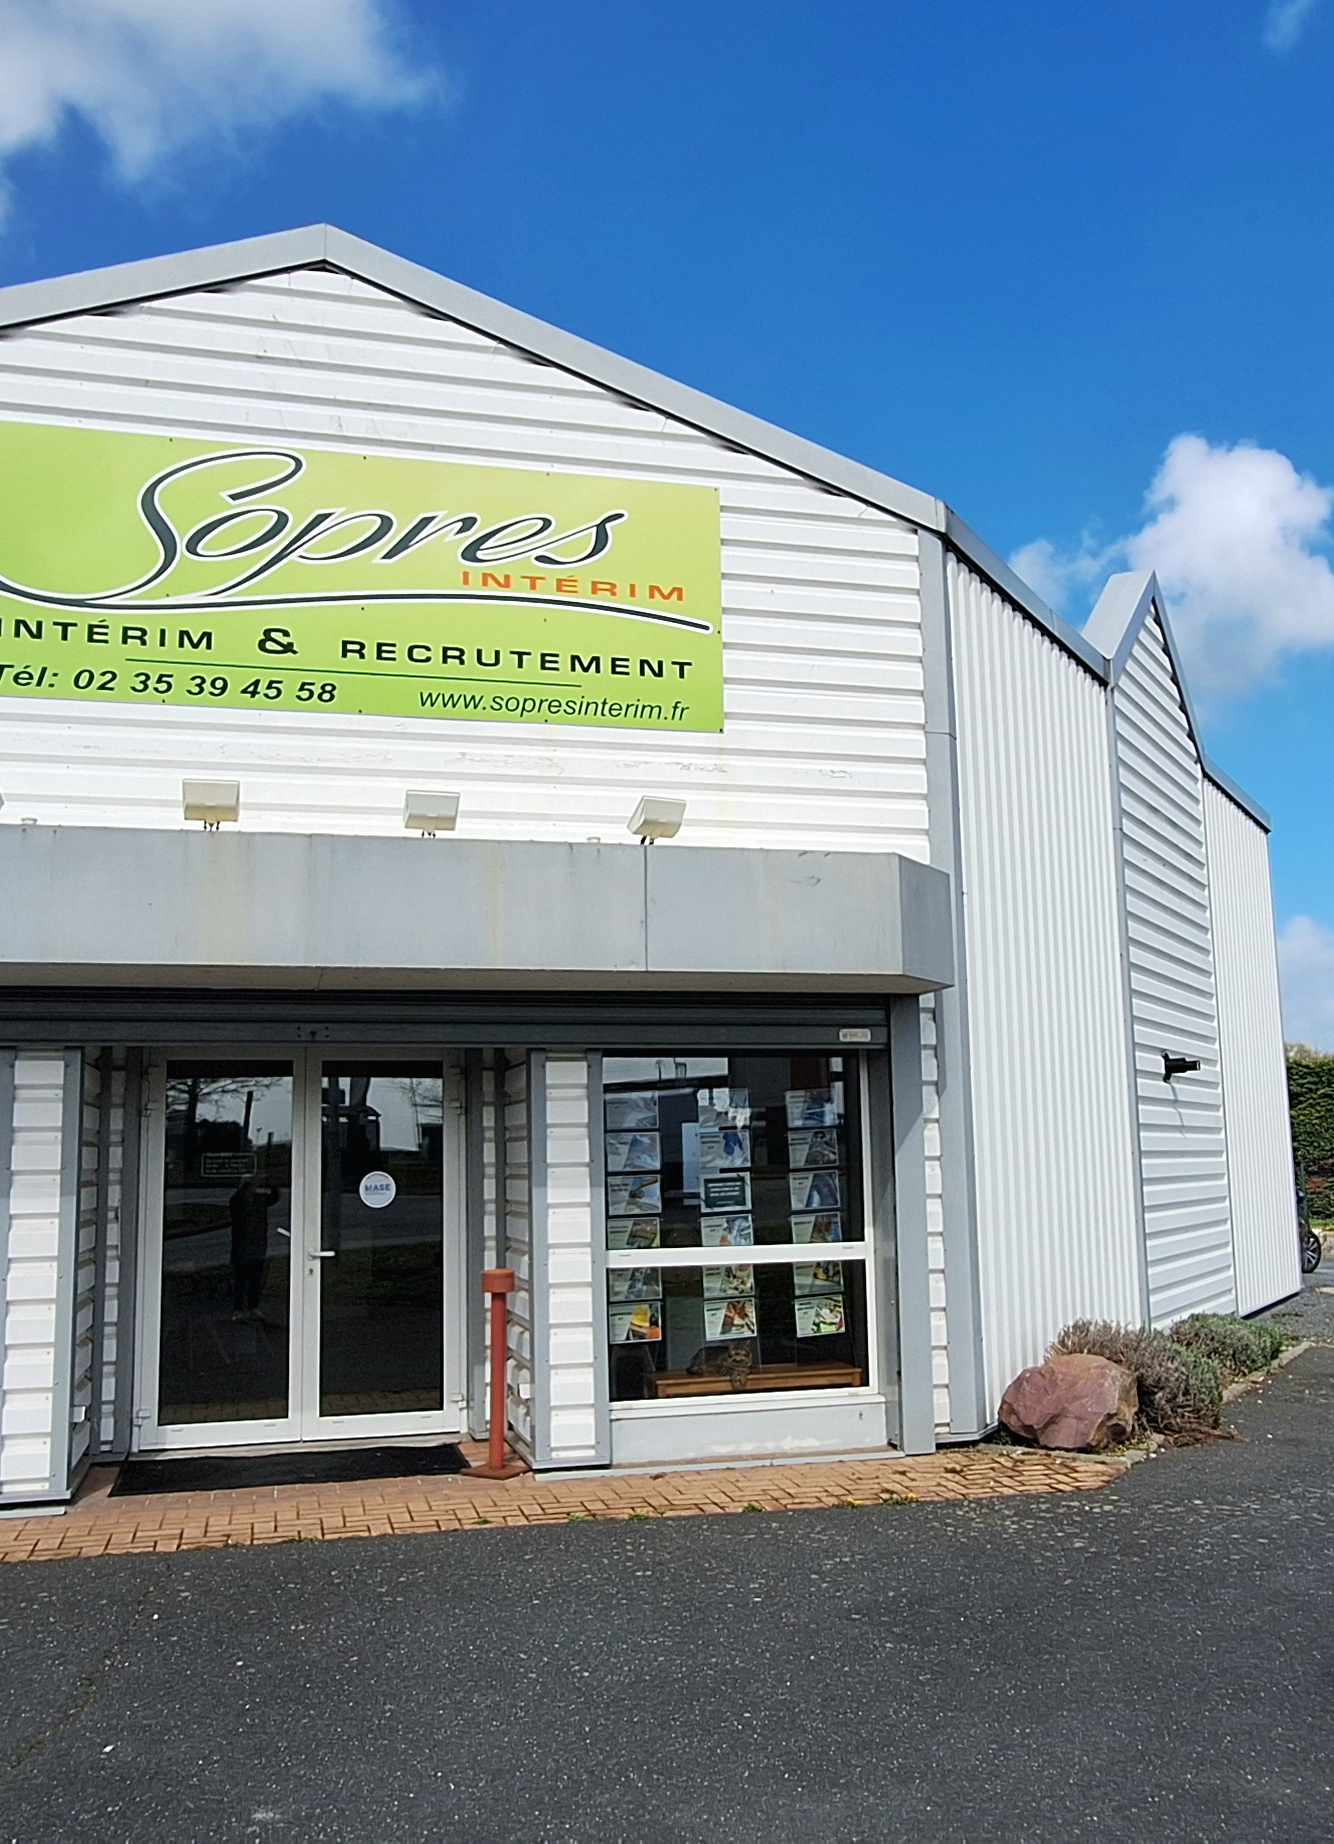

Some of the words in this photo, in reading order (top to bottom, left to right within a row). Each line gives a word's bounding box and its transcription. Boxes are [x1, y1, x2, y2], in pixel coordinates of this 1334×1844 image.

[133, 449, 628, 599] Sopres
[461, 570, 684, 602] INTÉRIM
[257, 626, 299, 655] &
[341, 638, 693, 680] RECRUTEMENT
[72, 668, 118, 692] 02
[129, 671, 174, 695] 35
[185, 674, 229, 698] 39
[239, 677, 285, 701] 45
[295, 680, 338, 704] 58
[419, 690, 691, 722] www.sopresinterim.fr
